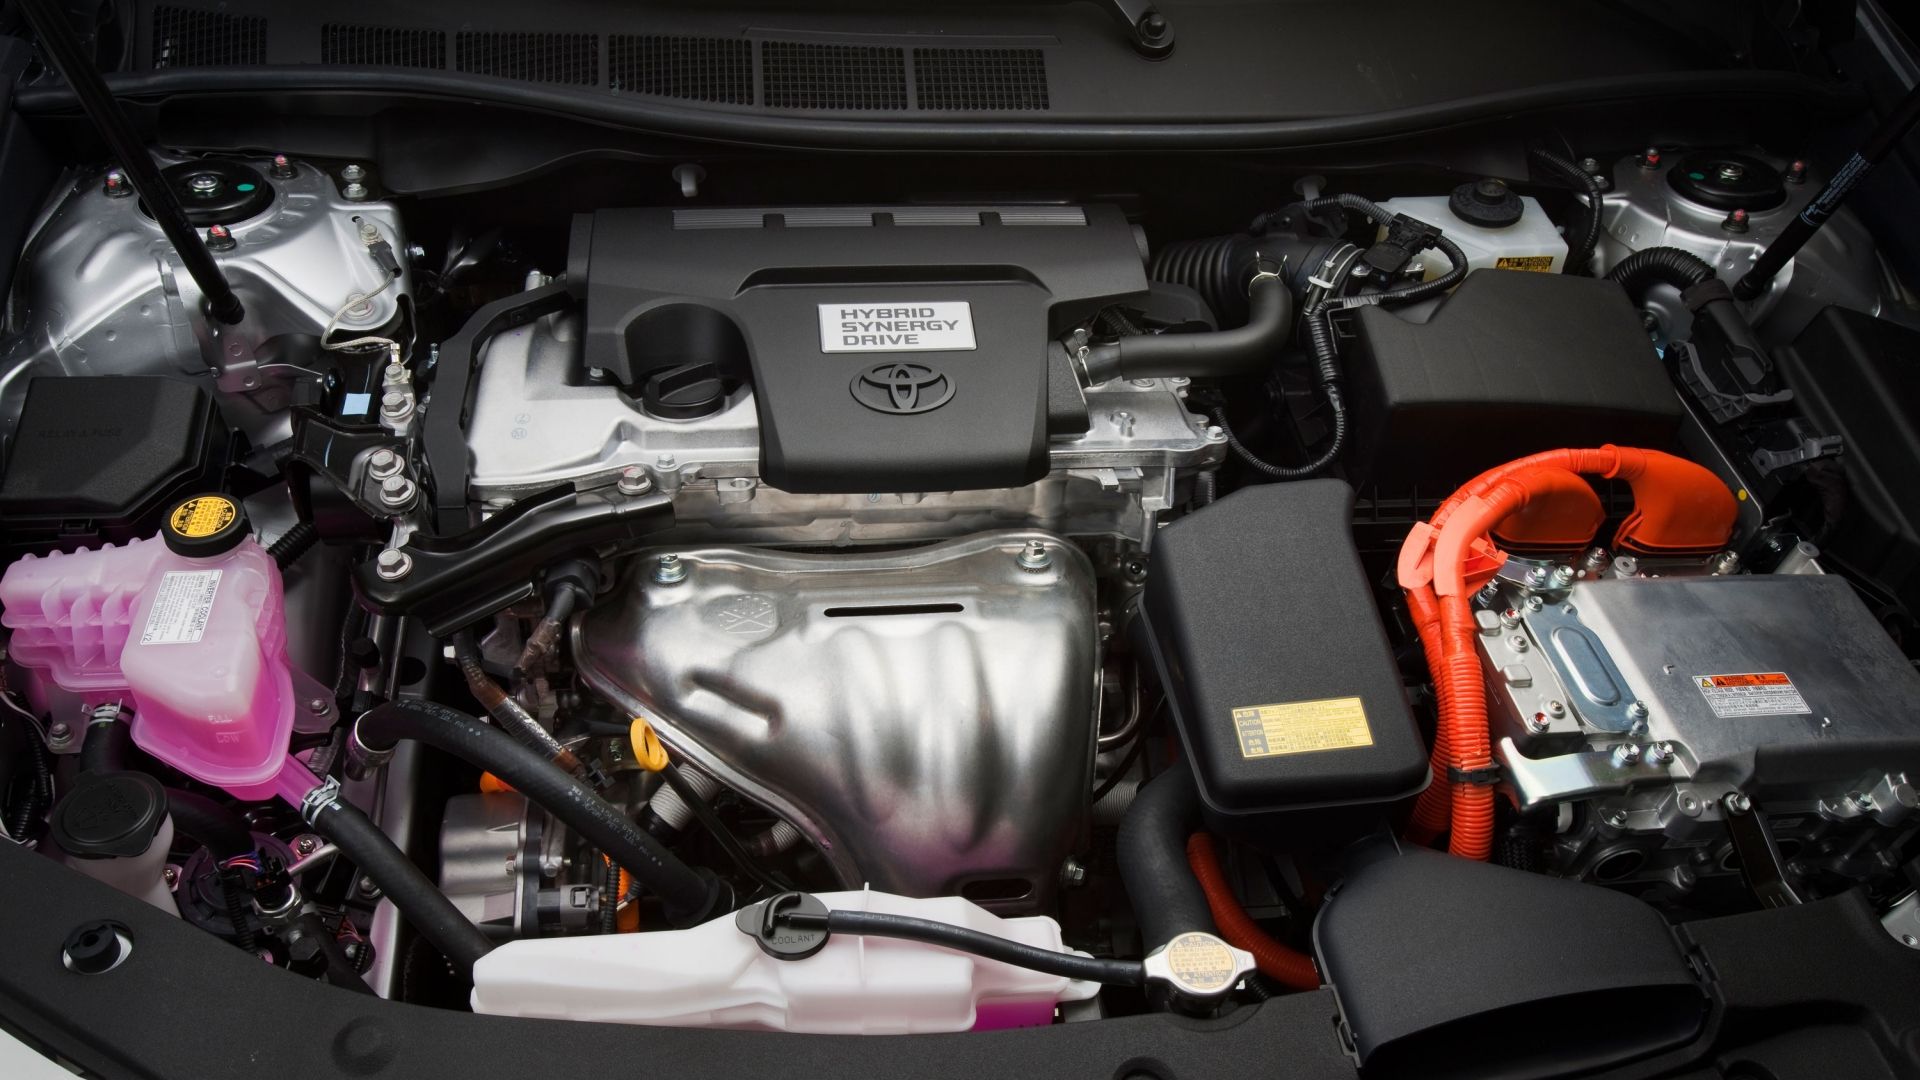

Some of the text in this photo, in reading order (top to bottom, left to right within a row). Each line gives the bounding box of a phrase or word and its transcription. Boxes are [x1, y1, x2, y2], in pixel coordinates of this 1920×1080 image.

[841, 308, 935, 319] HYBRID
[842, 320, 959, 332] SYNERGY
[843, 334, 920, 346] DRIVE
[196, 606, 209, 631] COOLANT
[771, 934, 815, 945] COOLANT
